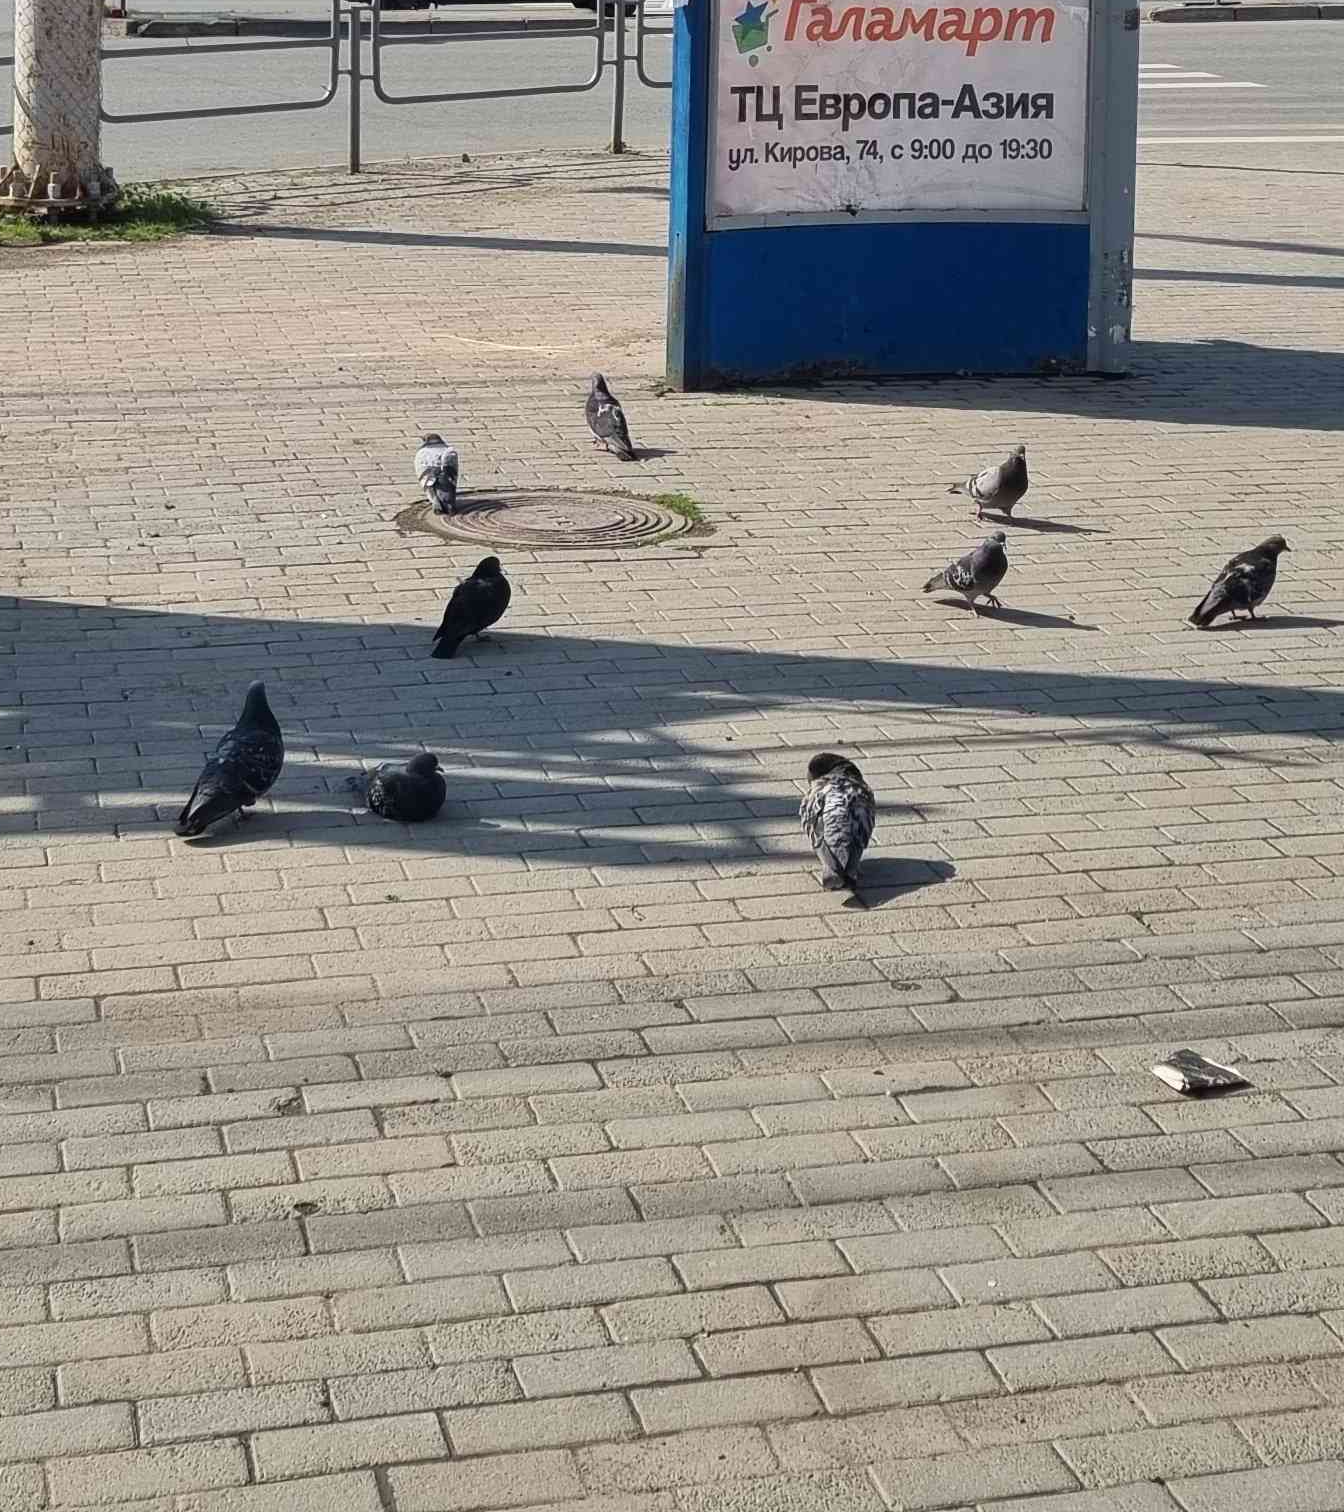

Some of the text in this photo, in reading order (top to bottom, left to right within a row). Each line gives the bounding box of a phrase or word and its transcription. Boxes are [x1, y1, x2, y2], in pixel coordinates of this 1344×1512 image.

[729, 82, 1055, 132] ТЦ Европа-Азия
[728, 137, 1054, 171] ул. Кирова, 74, с 9:00 до 19:30
